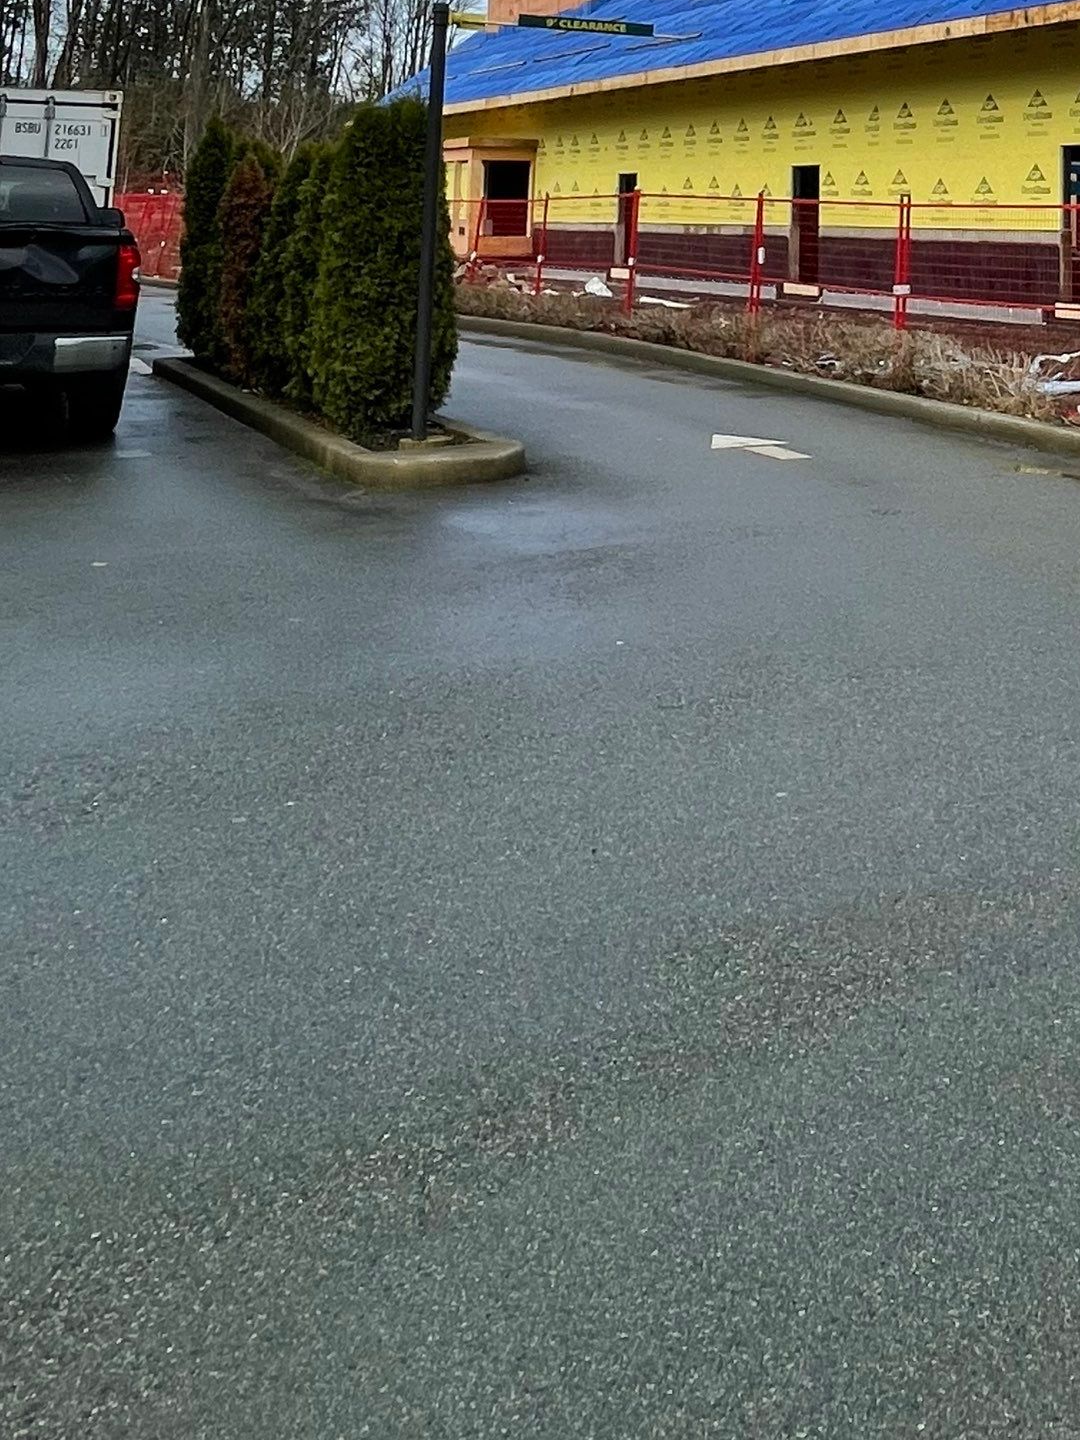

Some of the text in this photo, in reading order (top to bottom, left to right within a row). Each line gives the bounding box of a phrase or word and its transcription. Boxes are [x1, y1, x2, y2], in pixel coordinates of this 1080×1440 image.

[559, 19, 627, 33] CLEARANCE
[15, 122, 41, 134] BSBU
[54, 124, 91, 136] 216631
[54, 138, 79, 150] 22G1
